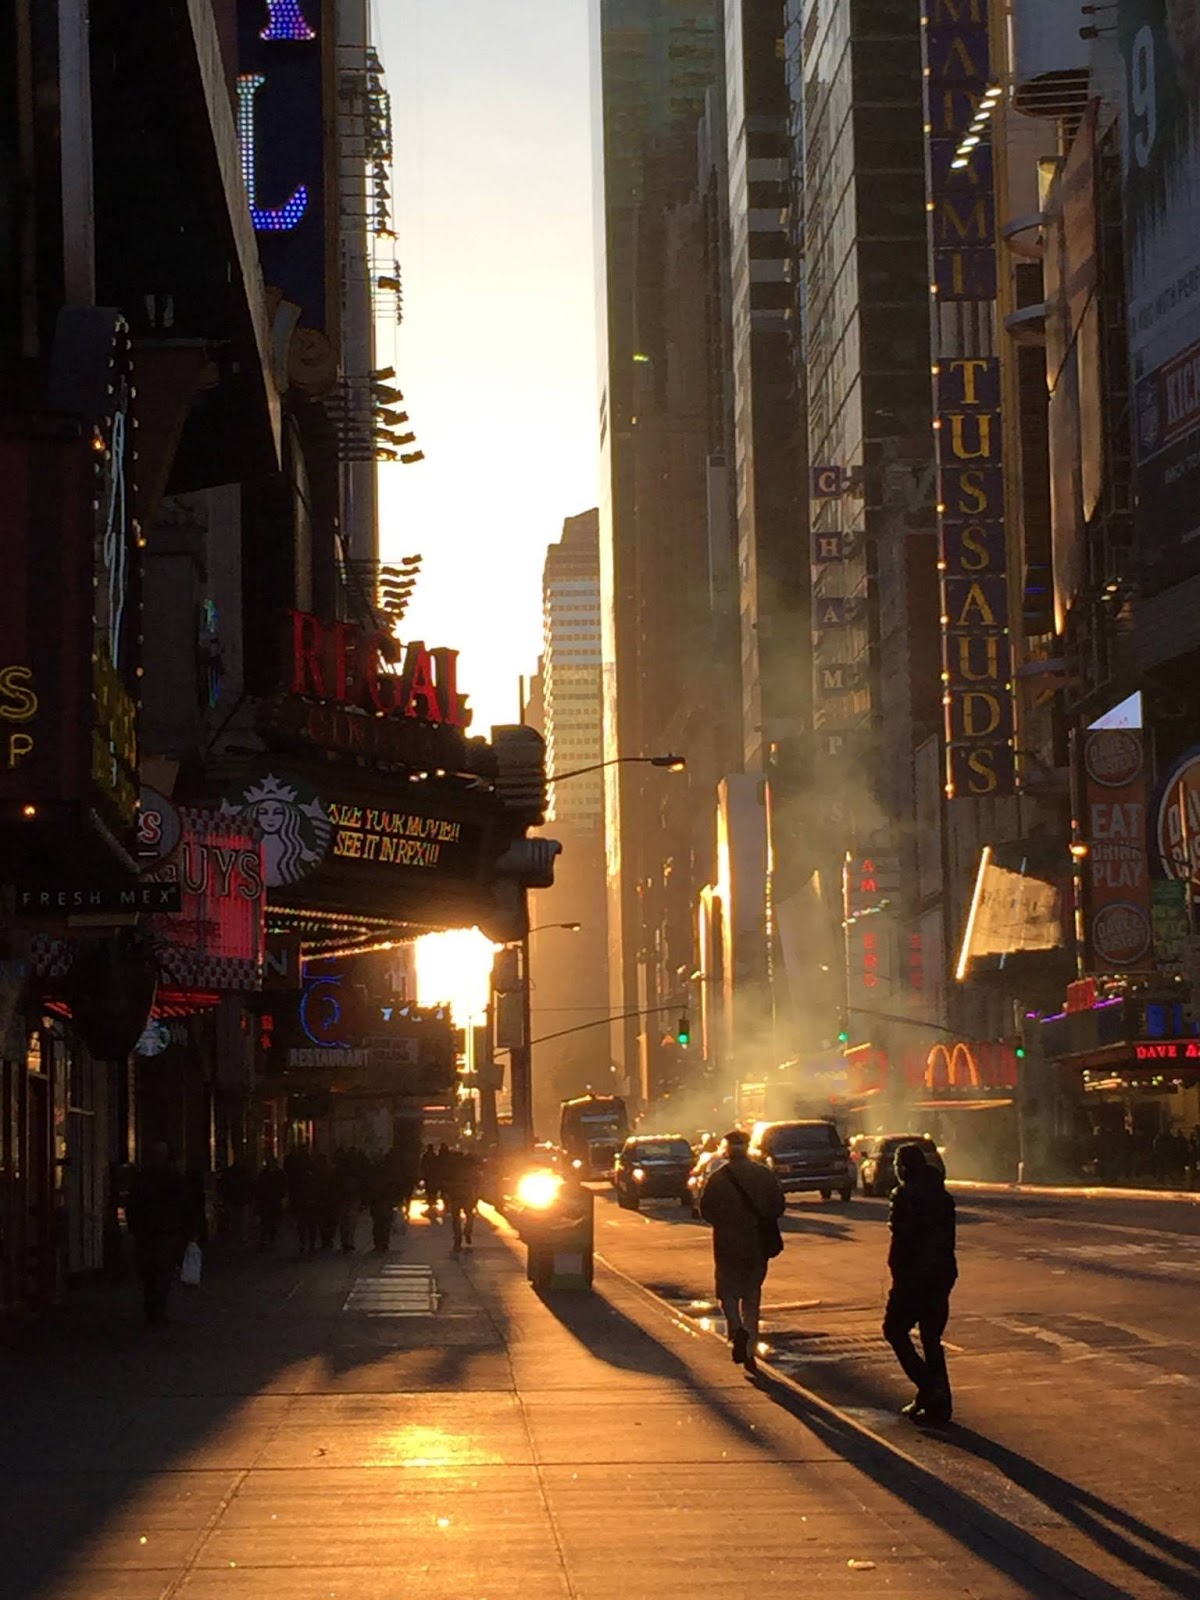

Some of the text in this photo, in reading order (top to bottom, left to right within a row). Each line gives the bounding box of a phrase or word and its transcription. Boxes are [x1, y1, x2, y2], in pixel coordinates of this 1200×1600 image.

[1091, 803, 1143, 838] EAT
[333, 831, 364, 858] SEE
[1093, 860, 1143, 887] PLAY
[22, 891, 101, 906] FRESH
[288, 1048, 369, 1068] RESTAURANT
[1135, 1045, 1178, 1060] DAVE
